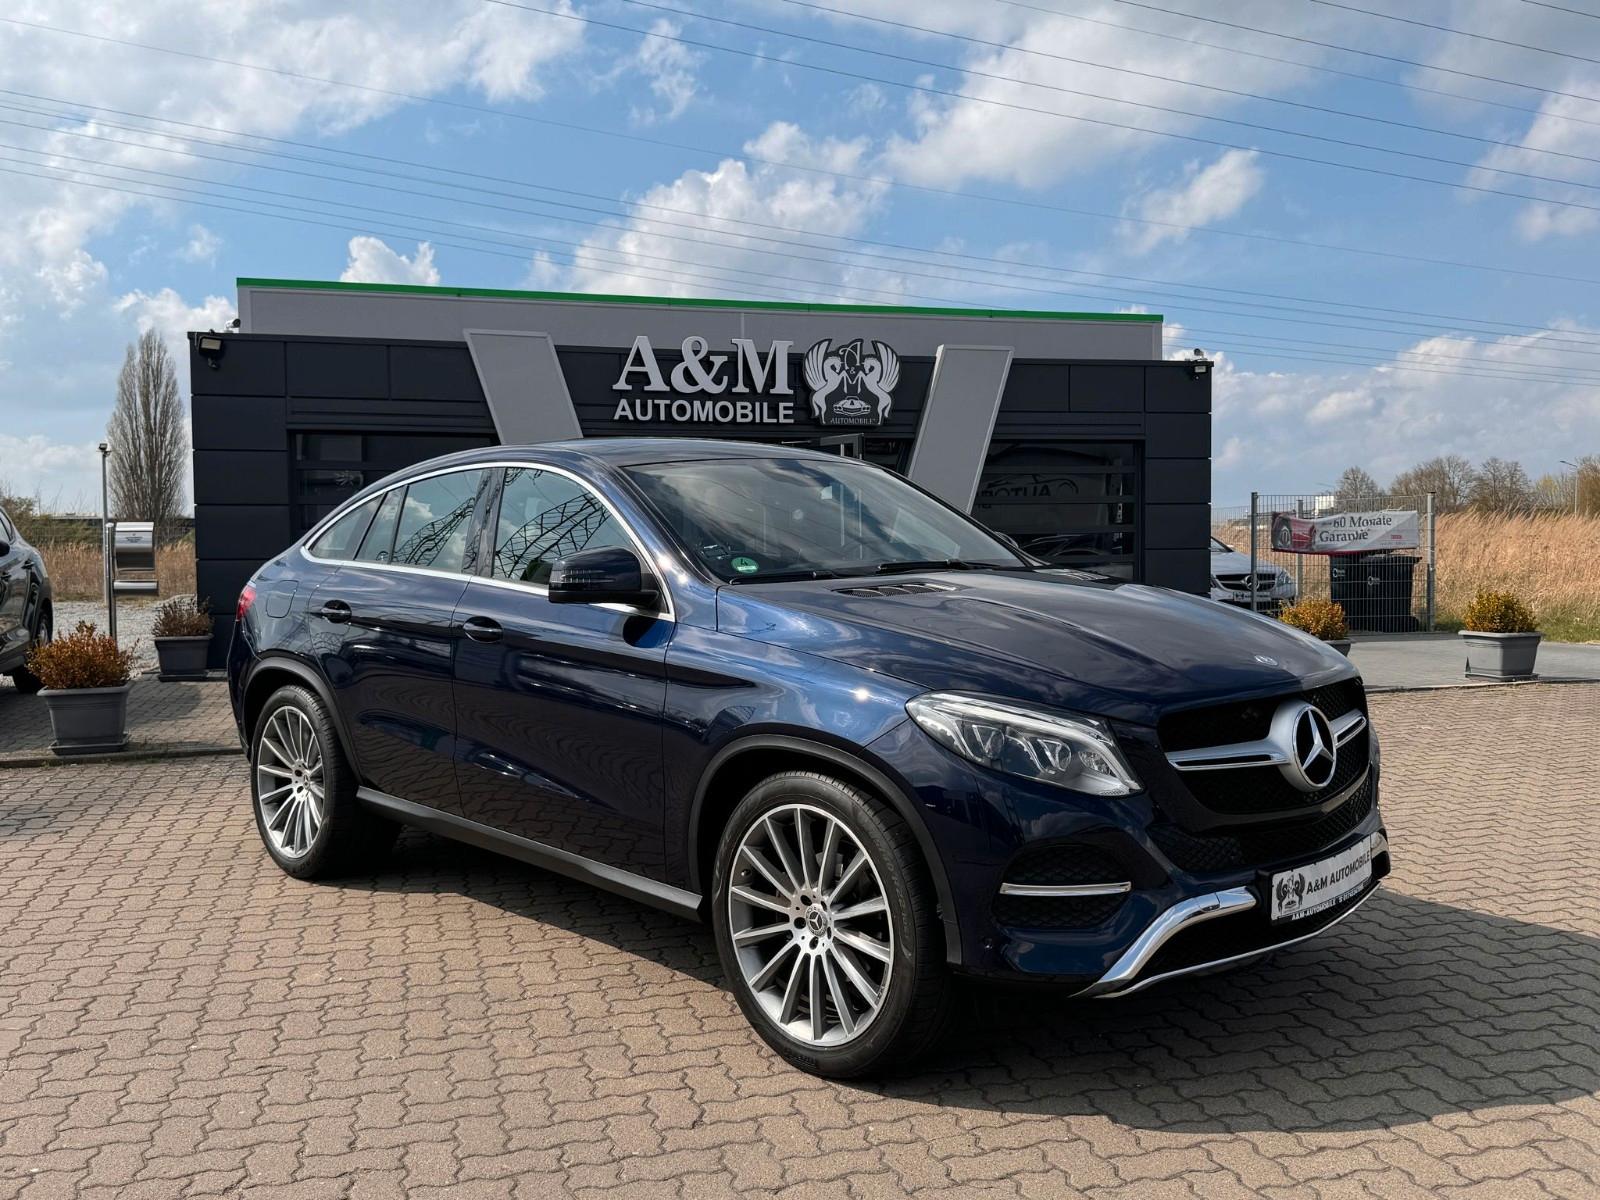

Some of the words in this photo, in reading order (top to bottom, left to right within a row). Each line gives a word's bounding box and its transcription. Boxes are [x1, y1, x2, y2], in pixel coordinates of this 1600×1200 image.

[612, 335, 794, 394] A&M
[613, 399, 794, 424] AUTOMOBILE
[1306, 876, 1328, 895] A&M
[1329, 850, 1370, 884] AUTOMOBILE
